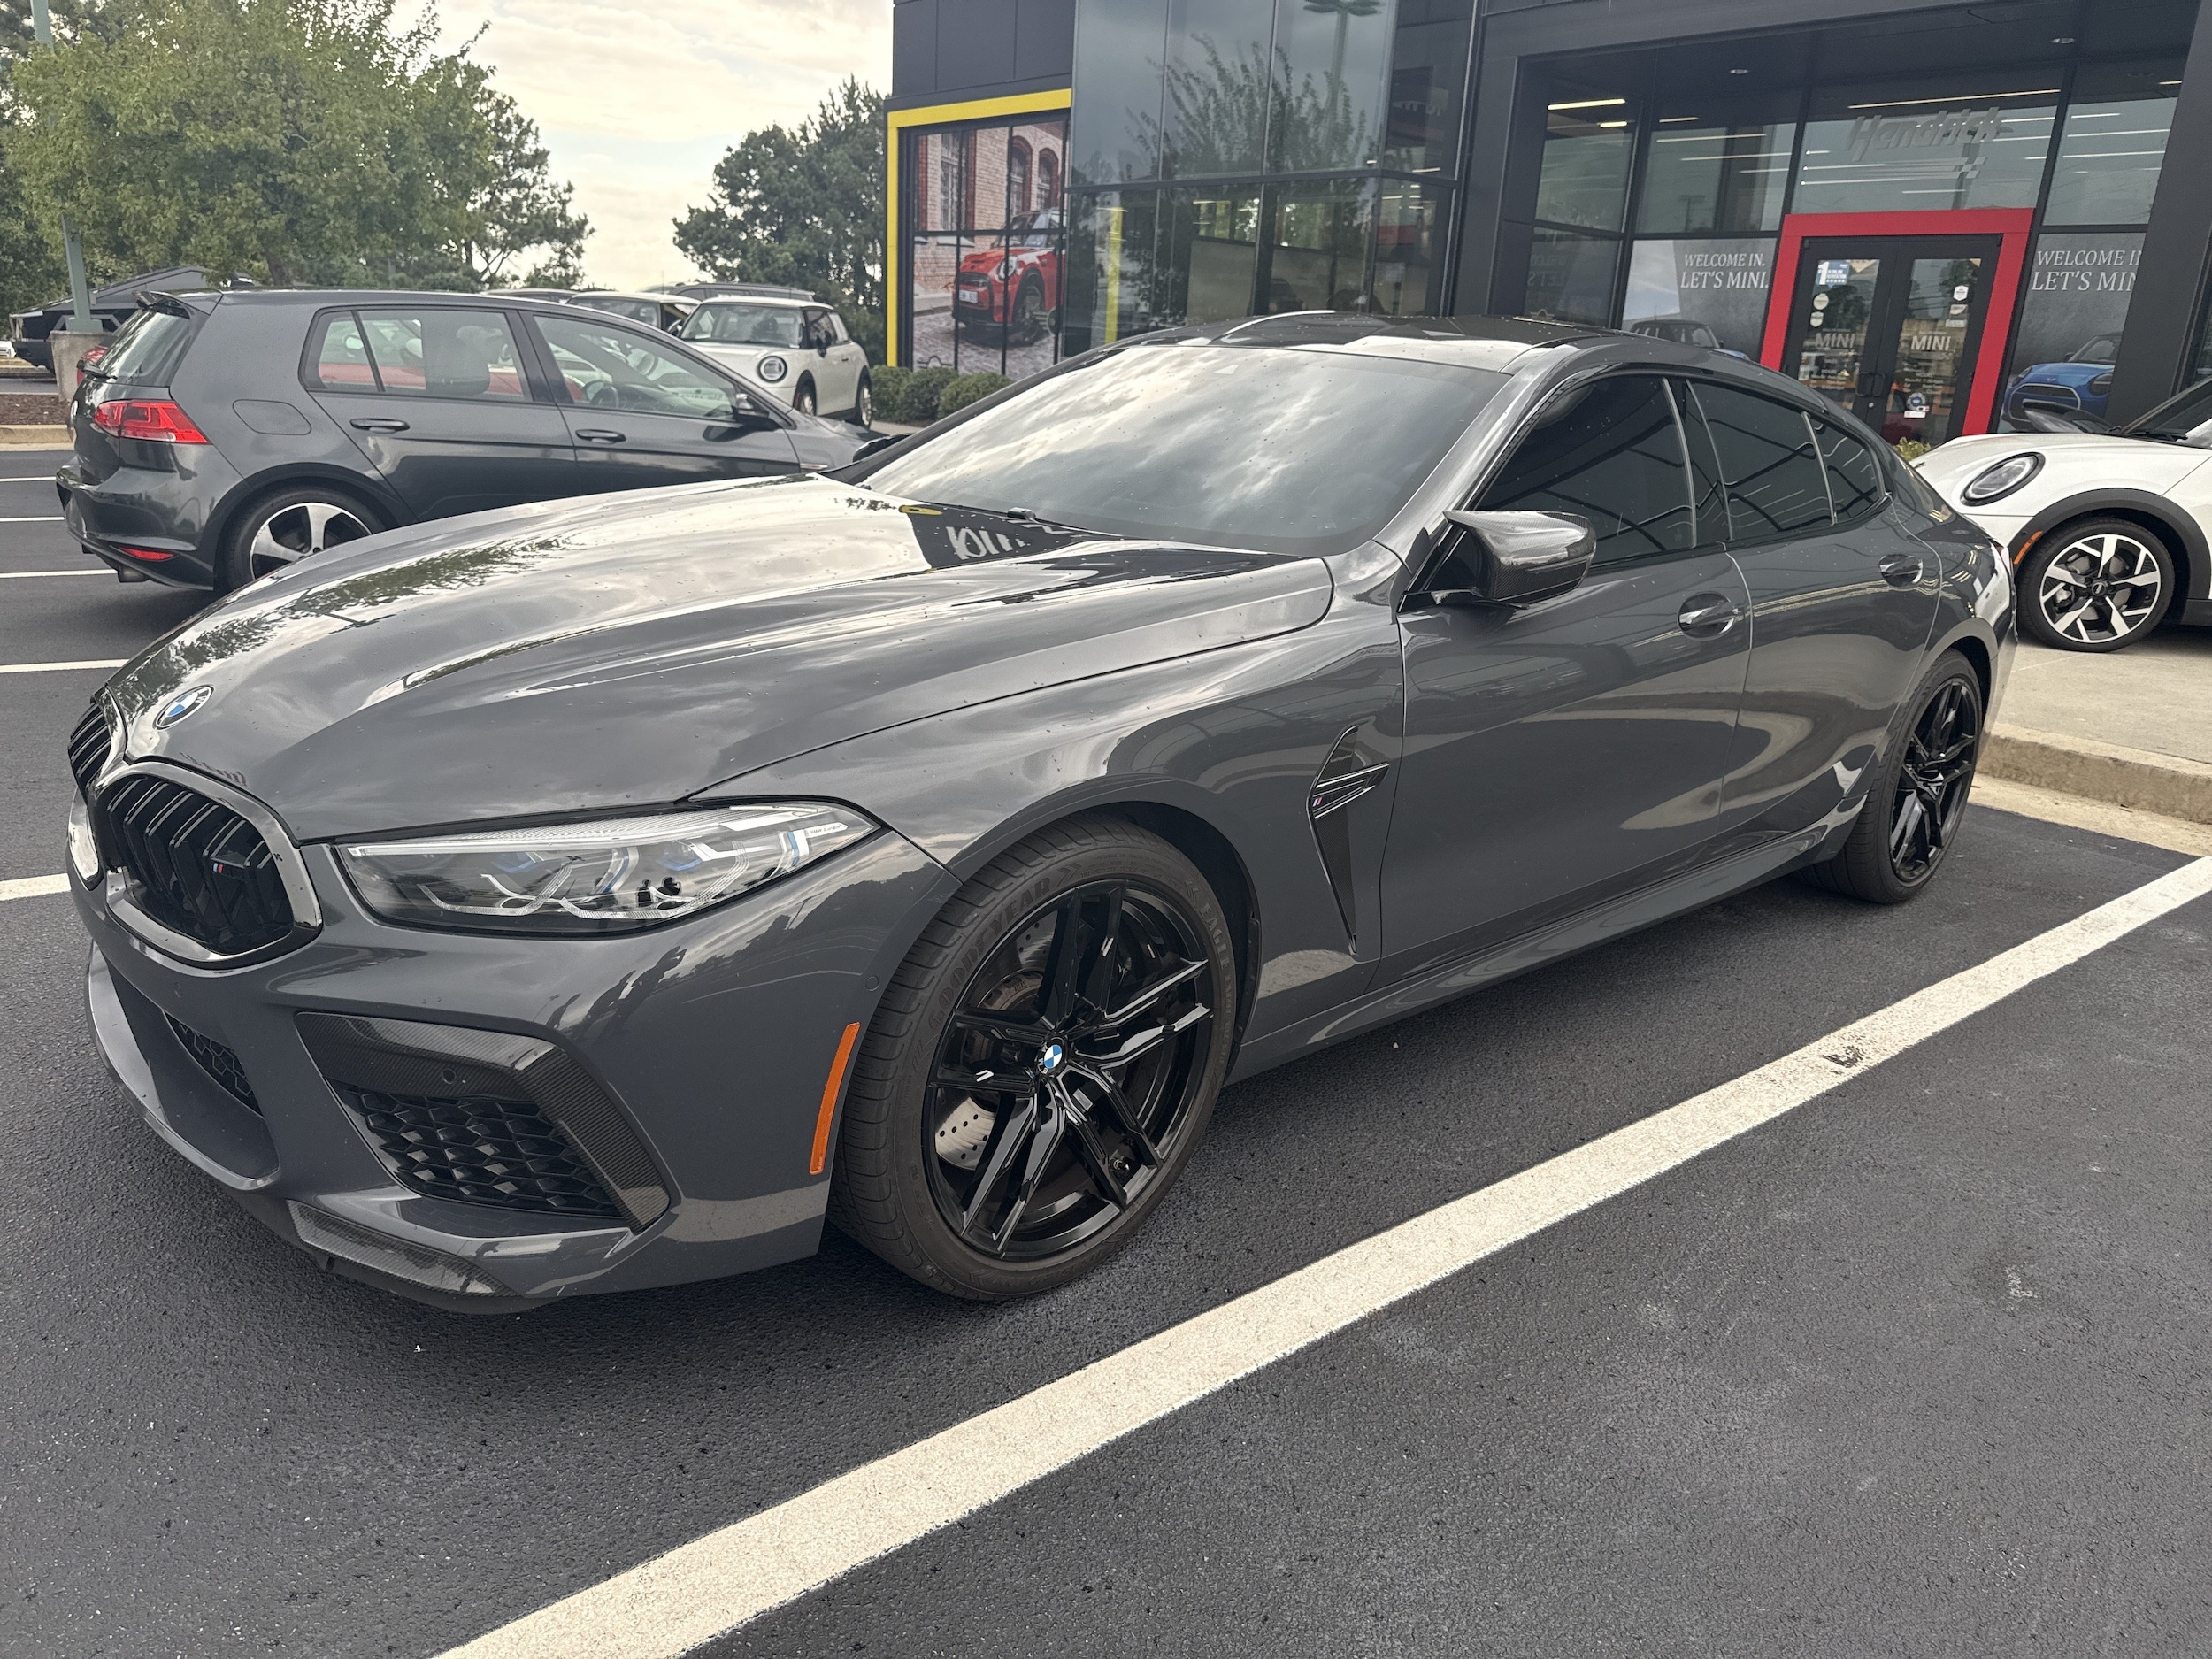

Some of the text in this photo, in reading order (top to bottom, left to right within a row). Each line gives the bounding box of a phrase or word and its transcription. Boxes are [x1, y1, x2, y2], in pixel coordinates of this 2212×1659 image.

[1844, 106, 2013, 162] Hendrick
[1684, 252, 1766, 267] WELCOME IN.
[2037, 250, 2126, 266] WELCOME
[1680, 270, 1769, 289] LET'S MINI.
[2031, 270, 2093, 291] LET'S
[1814, 332, 1855, 349] MINI
[1910, 334, 1952, 351] MINI
[1199, 902, 1233, 971] EAGLE
[927, 876, 1053, 1031] GOODYEAR
